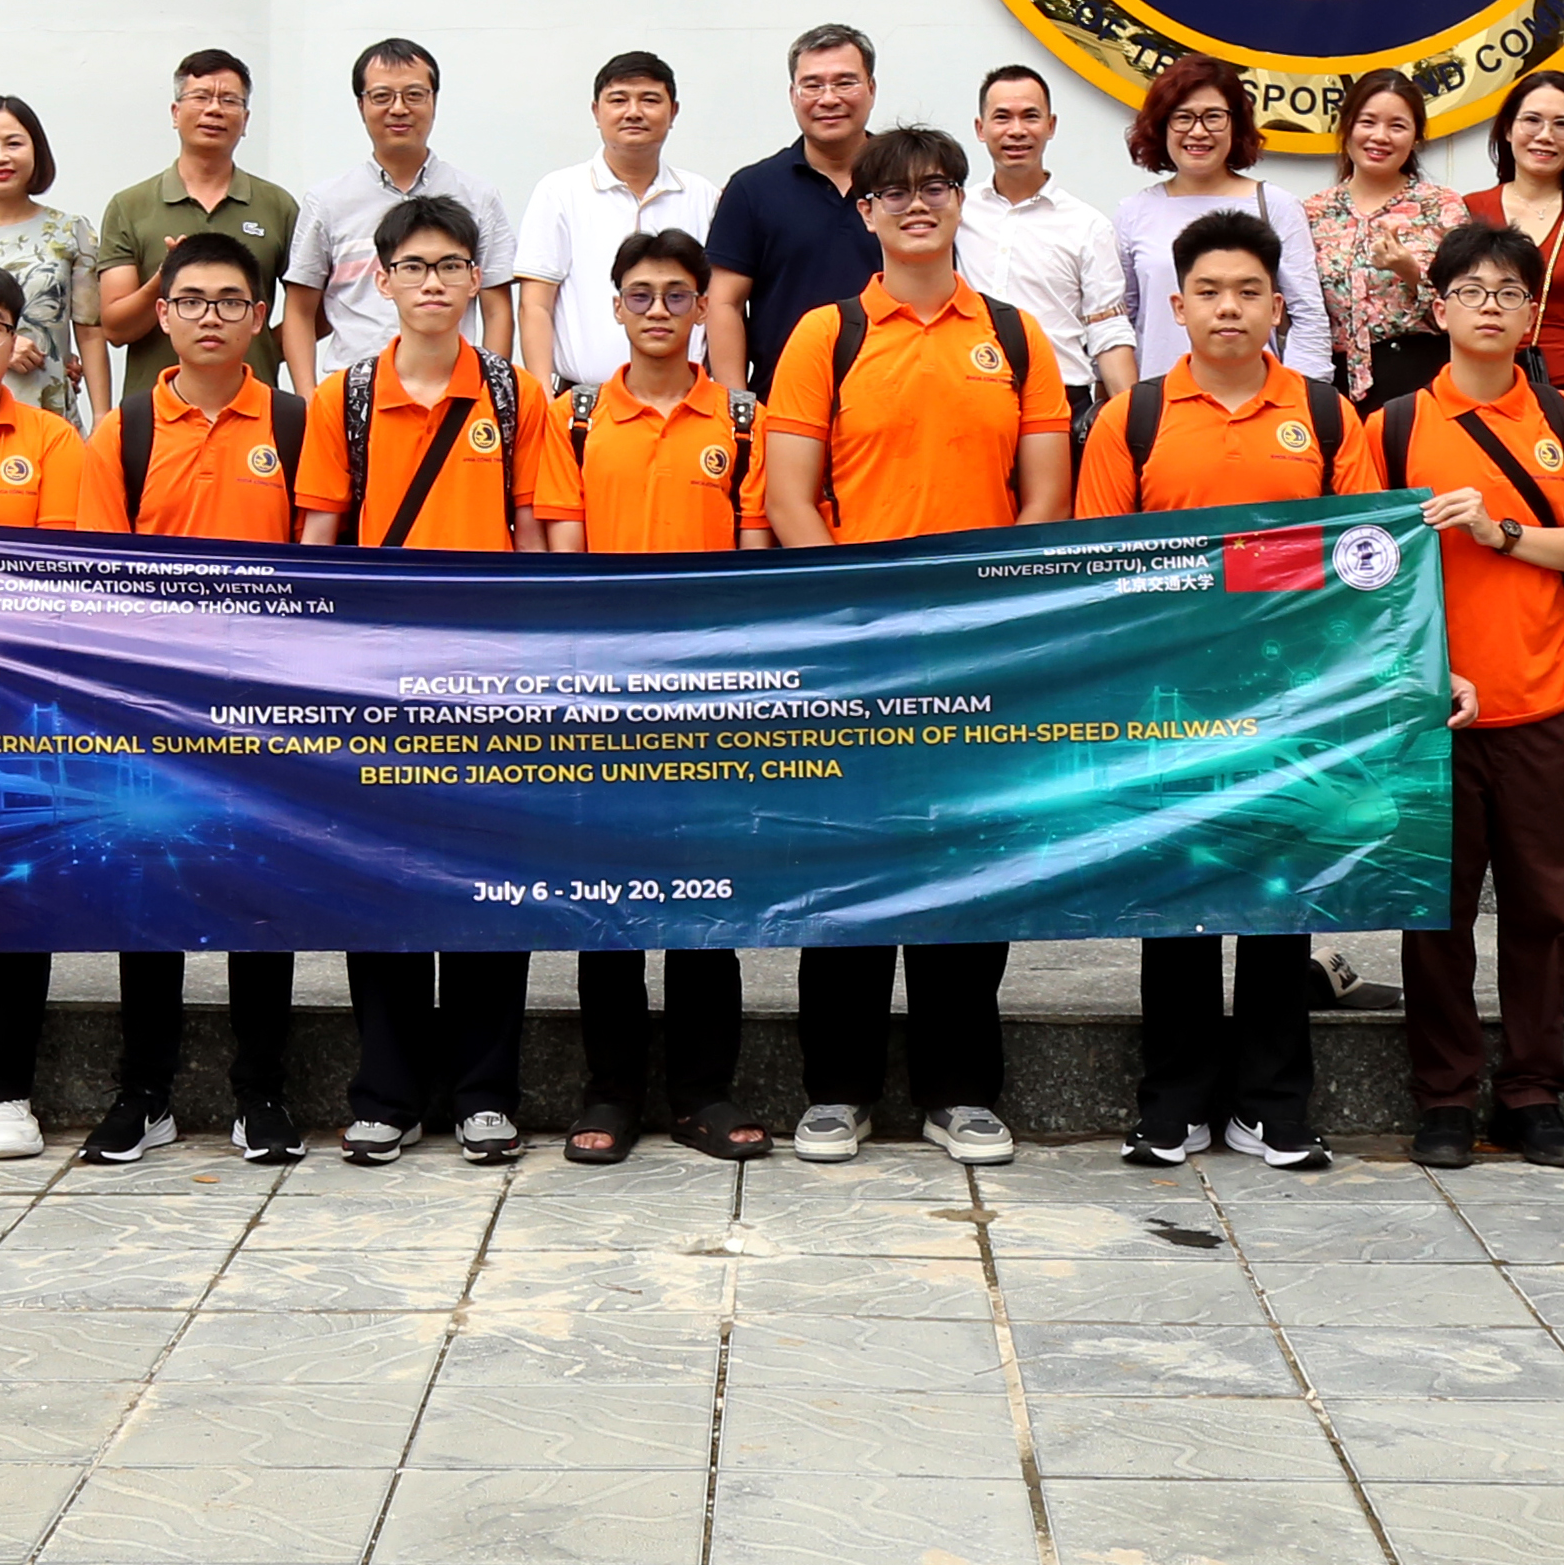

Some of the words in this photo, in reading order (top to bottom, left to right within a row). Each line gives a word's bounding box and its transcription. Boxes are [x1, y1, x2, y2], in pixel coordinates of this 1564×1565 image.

[1117, 536, 1209, 553] JIAOTONG
[97, 561, 122, 574] OF
[125, 562, 232, 576] TRANSPORT
[234, 565, 275, 576] AND
[977, 561, 1083, 578] UNIVERSITY
[1086, 558, 1147, 576] (BJTU),
[1150, 554, 1209, 571] CHINA
[160, 581, 210, 596] (UTC),
[212, 582, 293, 594] VIETNAM
[1114, 574, 1215, 594] 北京交通大学
[69, 599, 102, 616] ĐẠI
[106, 600, 146, 616] HỌC
[149, 600, 194, 614] GIAO
[197, 597, 261, 614] THÔNG
[264, 599, 303, 617] VẬN
[306, 597, 334, 614] TẢI
[398, 676, 510, 696] FACULTY
[515, 675, 550, 694] OF
[556, 674, 621, 694] CIVIL
[627, 670, 802, 693] ENGINEERING
[209, 705, 357, 724] UNIVERSITY
[362, 706, 398, 724] OF
[403, 704, 557, 724] TRANSPORT
[562, 704, 619, 722] AND
[626, 698, 871, 722] COMMUNICATIONS,
[876, 694, 992, 716] VIETNAM
[151, 735, 261, 754] SUMMER
[267, 735, 343, 755] CAMP
[348, 735, 387, 754] ON
[394, 734, 479, 754] GREEN
[485, 734, 543, 753] AND
[549, 732, 710, 751] INTELLIGENT
[716, 726, 915, 749] CONSTRUCTION
[921, 725, 957, 744] OF
[964, 722, 1120, 744] HIGH-SPEED
[1127, 718, 1259, 740] RAILWAYS
[359, 765, 459, 785] BEIJING
[465, 763, 595, 784] JIAOTONG
[601, 760, 755, 783] UNIVERSITY,
[760, 759, 843, 779] CHINA
[473, 881, 526, 905] July
[532, 881, 548, 900] 6
[569, 879, 622, 904] July
[628, 880, 665, 902] 20,
[671, 879, 732, 899] 2026
